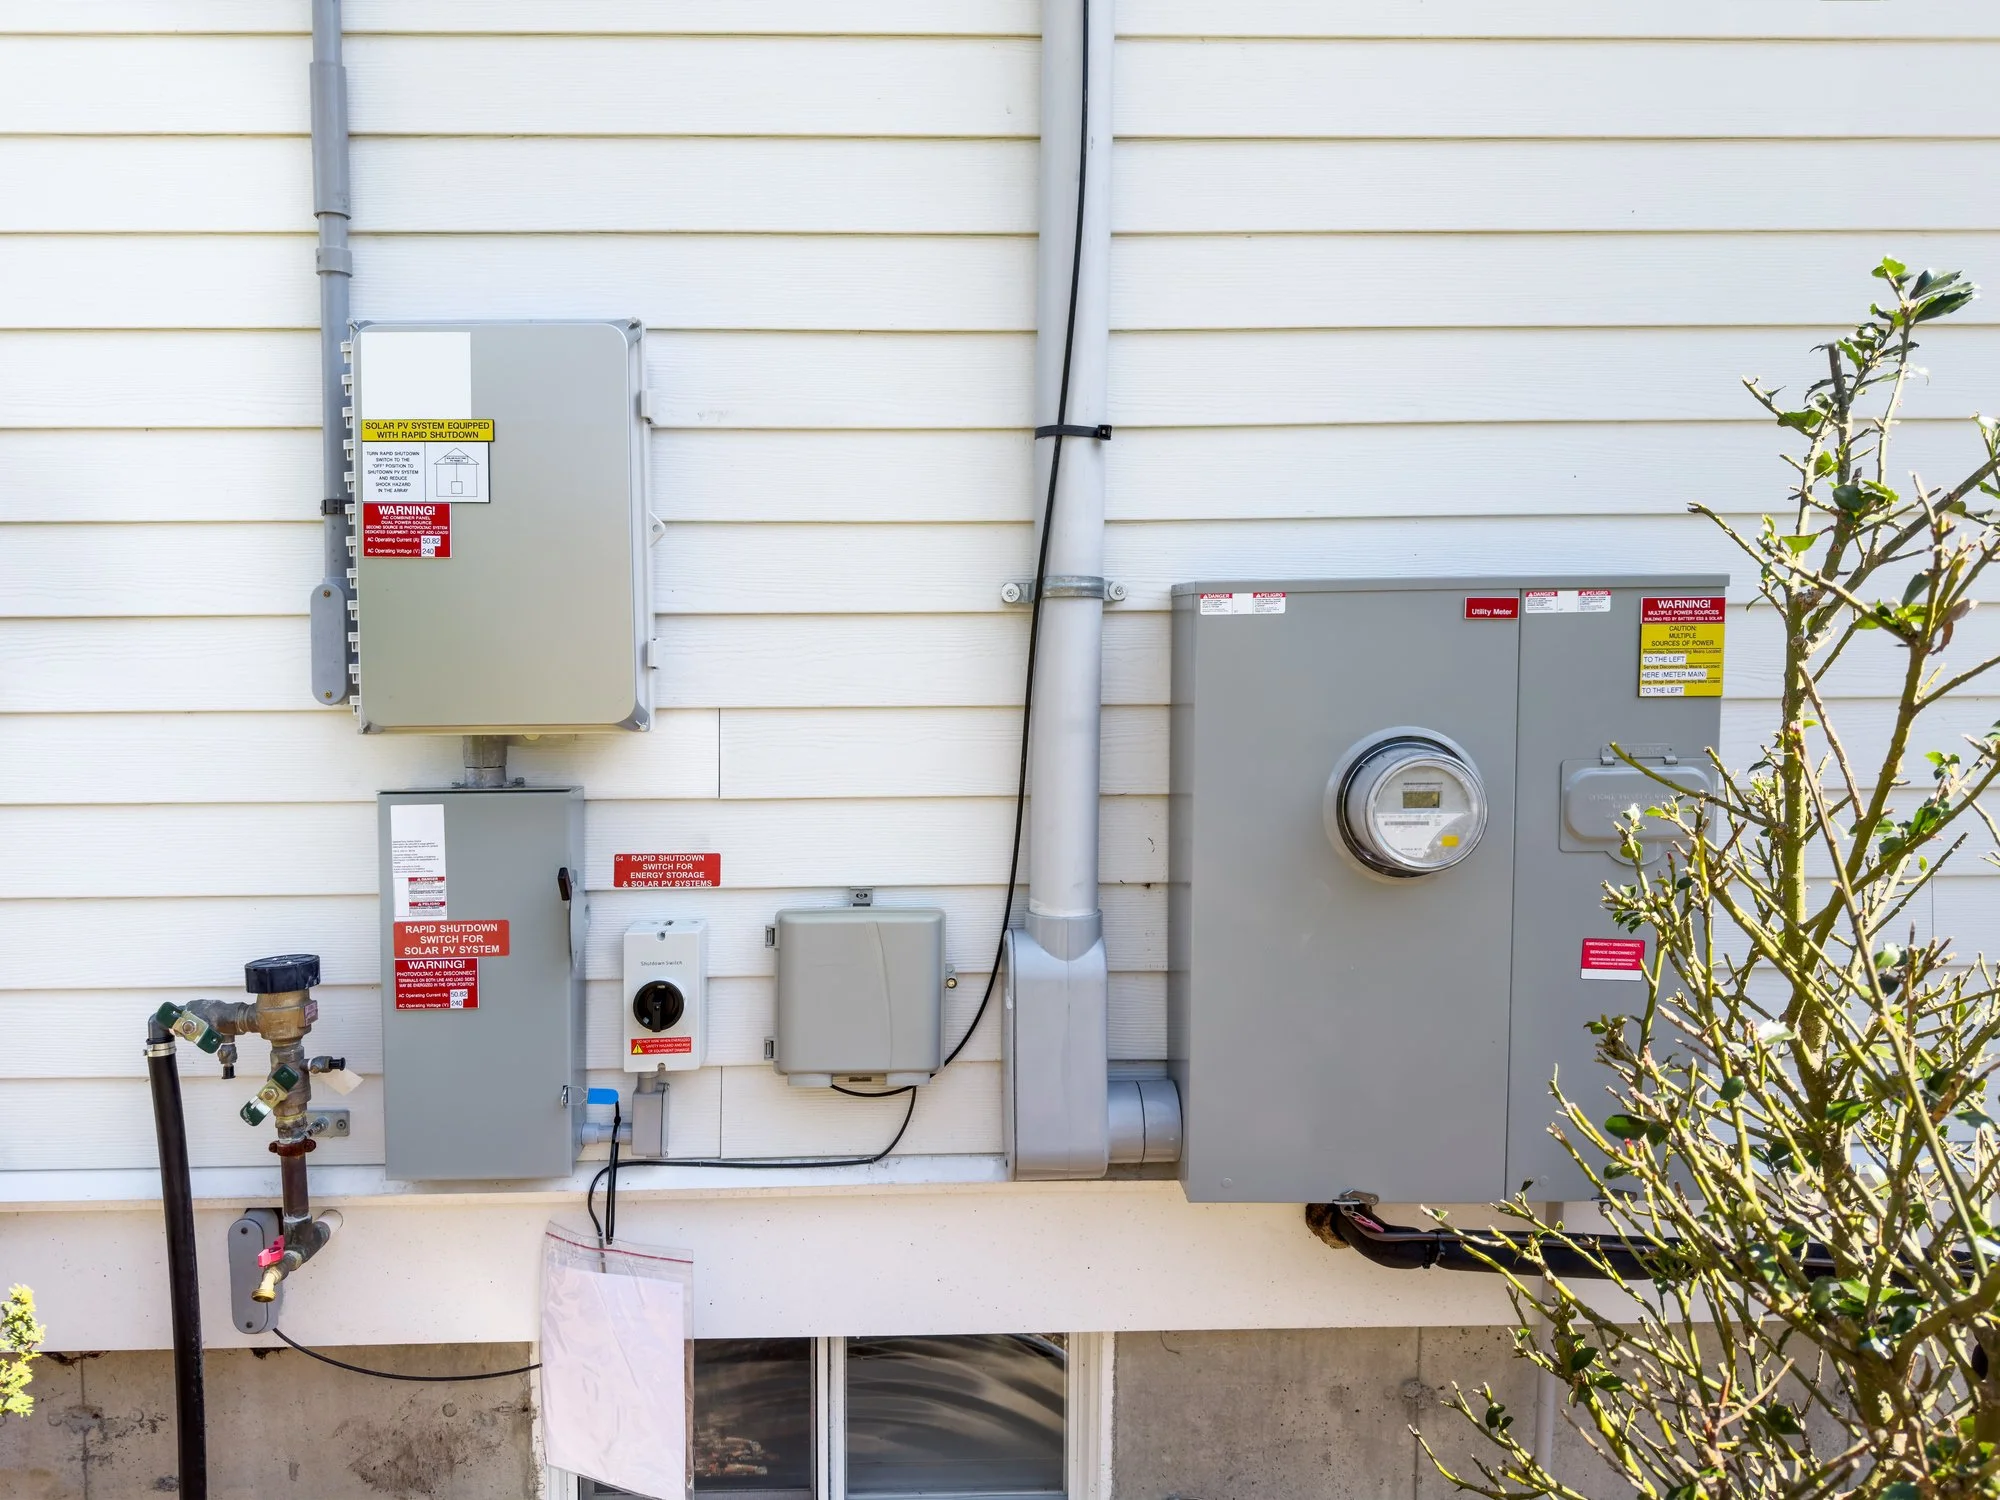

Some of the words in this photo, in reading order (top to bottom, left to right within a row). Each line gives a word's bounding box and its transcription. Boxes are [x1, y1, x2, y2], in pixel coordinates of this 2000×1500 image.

[378, 506, 435, 515] WARNING!
[1658, 600, 1710, 608] WARNING!
[1472, 608, 1491, 617] Utility
[405, 946, 439, 954] SOLAR
[443, 946, 455, 954] PV
[460, 945, 499, 953] SYSTEM
[408, 960, 465, 969] WARNING!
